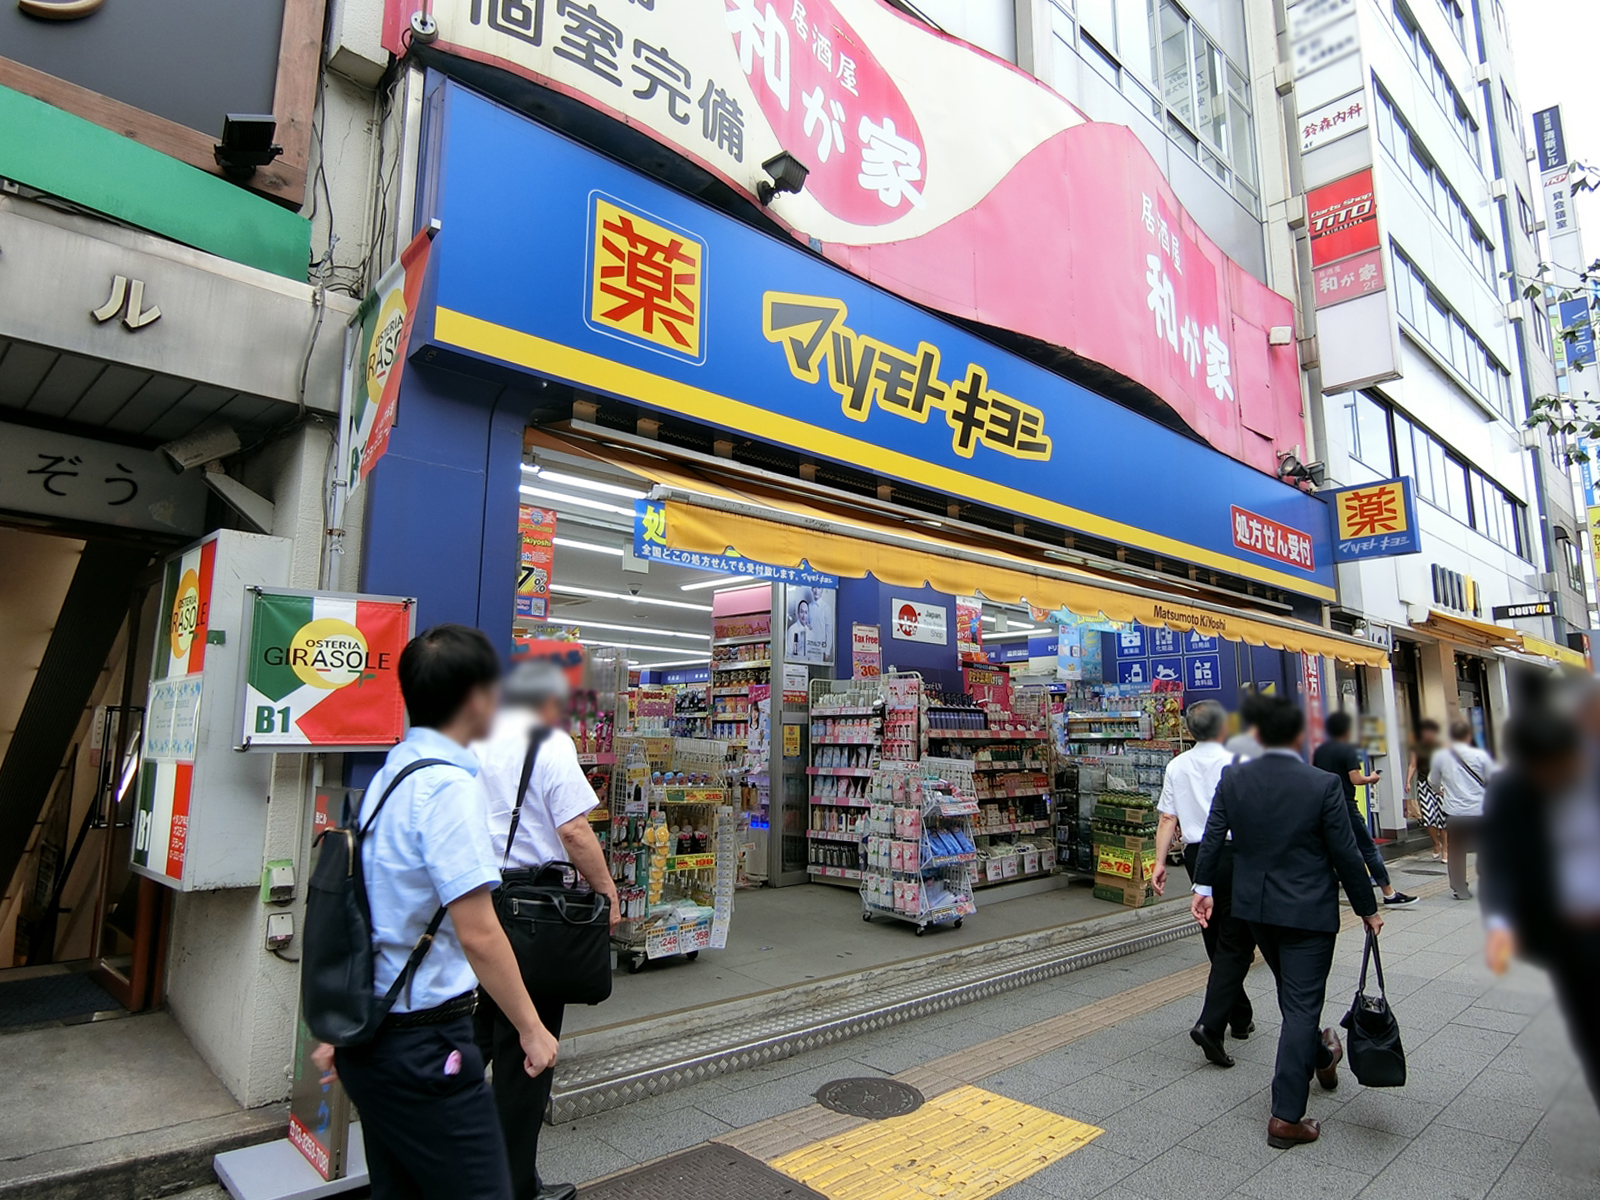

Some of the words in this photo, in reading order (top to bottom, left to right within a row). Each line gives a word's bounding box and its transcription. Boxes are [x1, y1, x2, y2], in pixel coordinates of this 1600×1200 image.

[790, 0, 859, 97] 居酒屋
[725, 0, 926, 211] 和が家
[1302, 103, 1362, 139] 鈴森内科
[1545, 174, 1567, 187] TKP
[1141, 192, 1182, 276] 居酒屋
[1322, 219, 1363, 237] AKIHABARA
[600, 213, 697, 350] 薬
[1320, 264, 1378, 294] 和が家
[1363, 279, 1379, 291] 2F
[1146, 254, 1234, 401] 和が家
[764, 292, 1050, 460] マツモトキヨシ
[27, 453, 138, 506] ぞう
[1345, 487, 1397, 536] 薬
[1235, 512, 1312, 566] 処方せん受付
[1154, 605, 1199, 626] Matsumoto
[1508, 604, 1550, 617] DOUTOR
[305, 638, 361, 650] OSTERIA
[854, 633, 864, 643] Tax
[865, 634, 878, 645] Free
[263, 646, 391, 670] GIRASOLE
[255, 705, 291, 734] B1
[136, 809, 152, 852] B1
[1114, 860, 1132, 874] 78
[662, 936, 678, 947] 248
